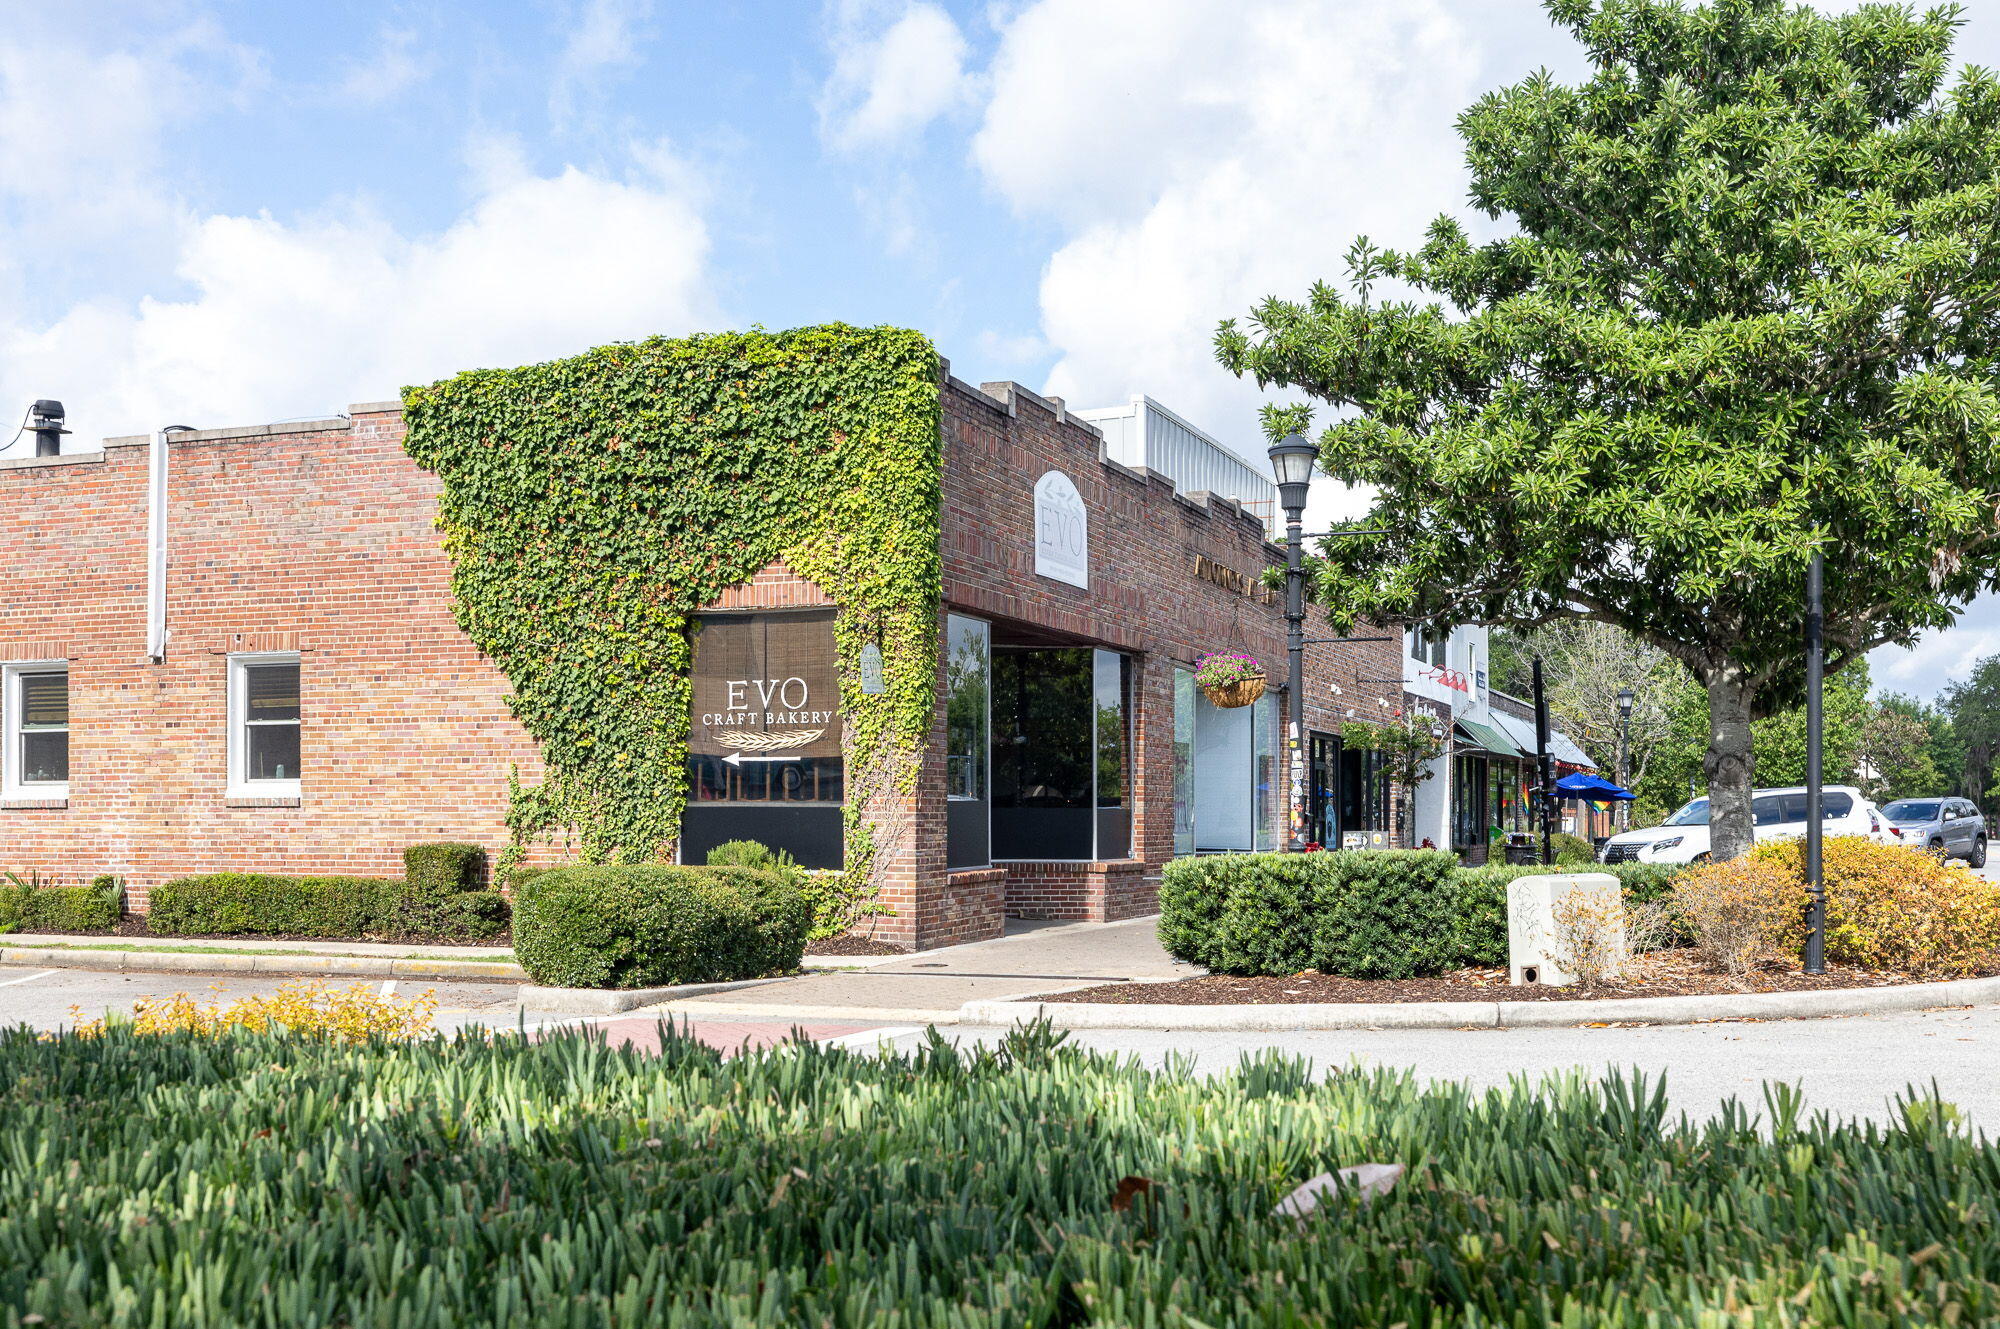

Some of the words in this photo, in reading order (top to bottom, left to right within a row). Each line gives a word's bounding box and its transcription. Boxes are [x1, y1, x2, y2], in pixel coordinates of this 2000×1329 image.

[1041, 505, 1082, 557] EVO
[864, 661, 882, 680] EVO
[726, 677, 808, 710] EVO
[702, 713, 758, 725] CRAFT
[765, 711, 832, 724] BAKERY
